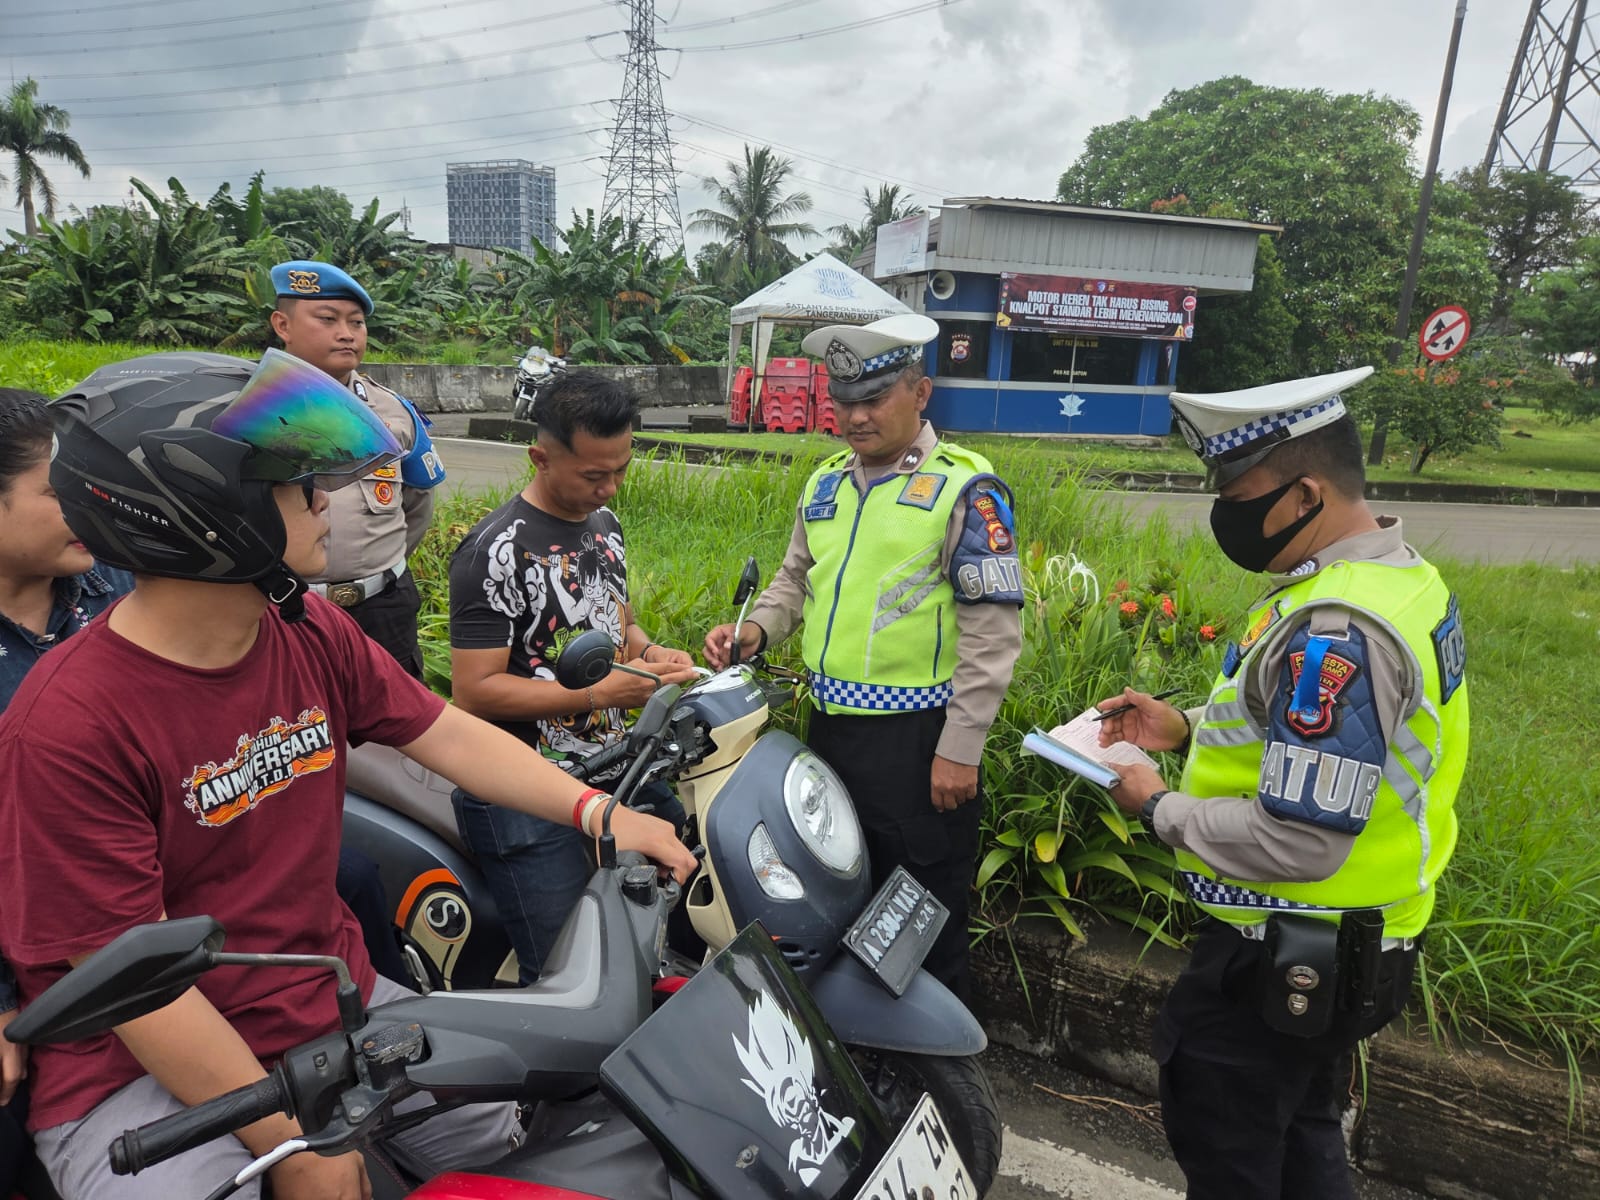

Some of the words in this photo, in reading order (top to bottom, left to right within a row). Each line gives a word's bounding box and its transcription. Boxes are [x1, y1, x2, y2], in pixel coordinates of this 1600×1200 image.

[785, 302, 834, 311] SATLANTAS
[1009, 301, 1050, 315] KNALPOT
[1052, 304, 1092, 318] STANDAR
[1093, 307, 1118, 320] LEBIH
[1118, 309, 1183, 324] MENENANGKAN
[1027, 290, 1060, 304] MOTOR
[1061, 293, 1090, 306] KEREN
[1091, 295, 1108, 308] TAK
[1109, 297, 1139, 310] HARUS
[1140, 299, 1169, 312] BISING
[805, 309, 857, 320] TANGERANG
[858, 312, 880, 320] KOTA
[110, 496, 169, 527] FIGHTER
[957, 557, 1024, 600] GAT
[200, 721, 331, 811] ANNIVERSARY
[1260, 739, 1382, 821] ATUR
[862, 940, 884, 962] A
